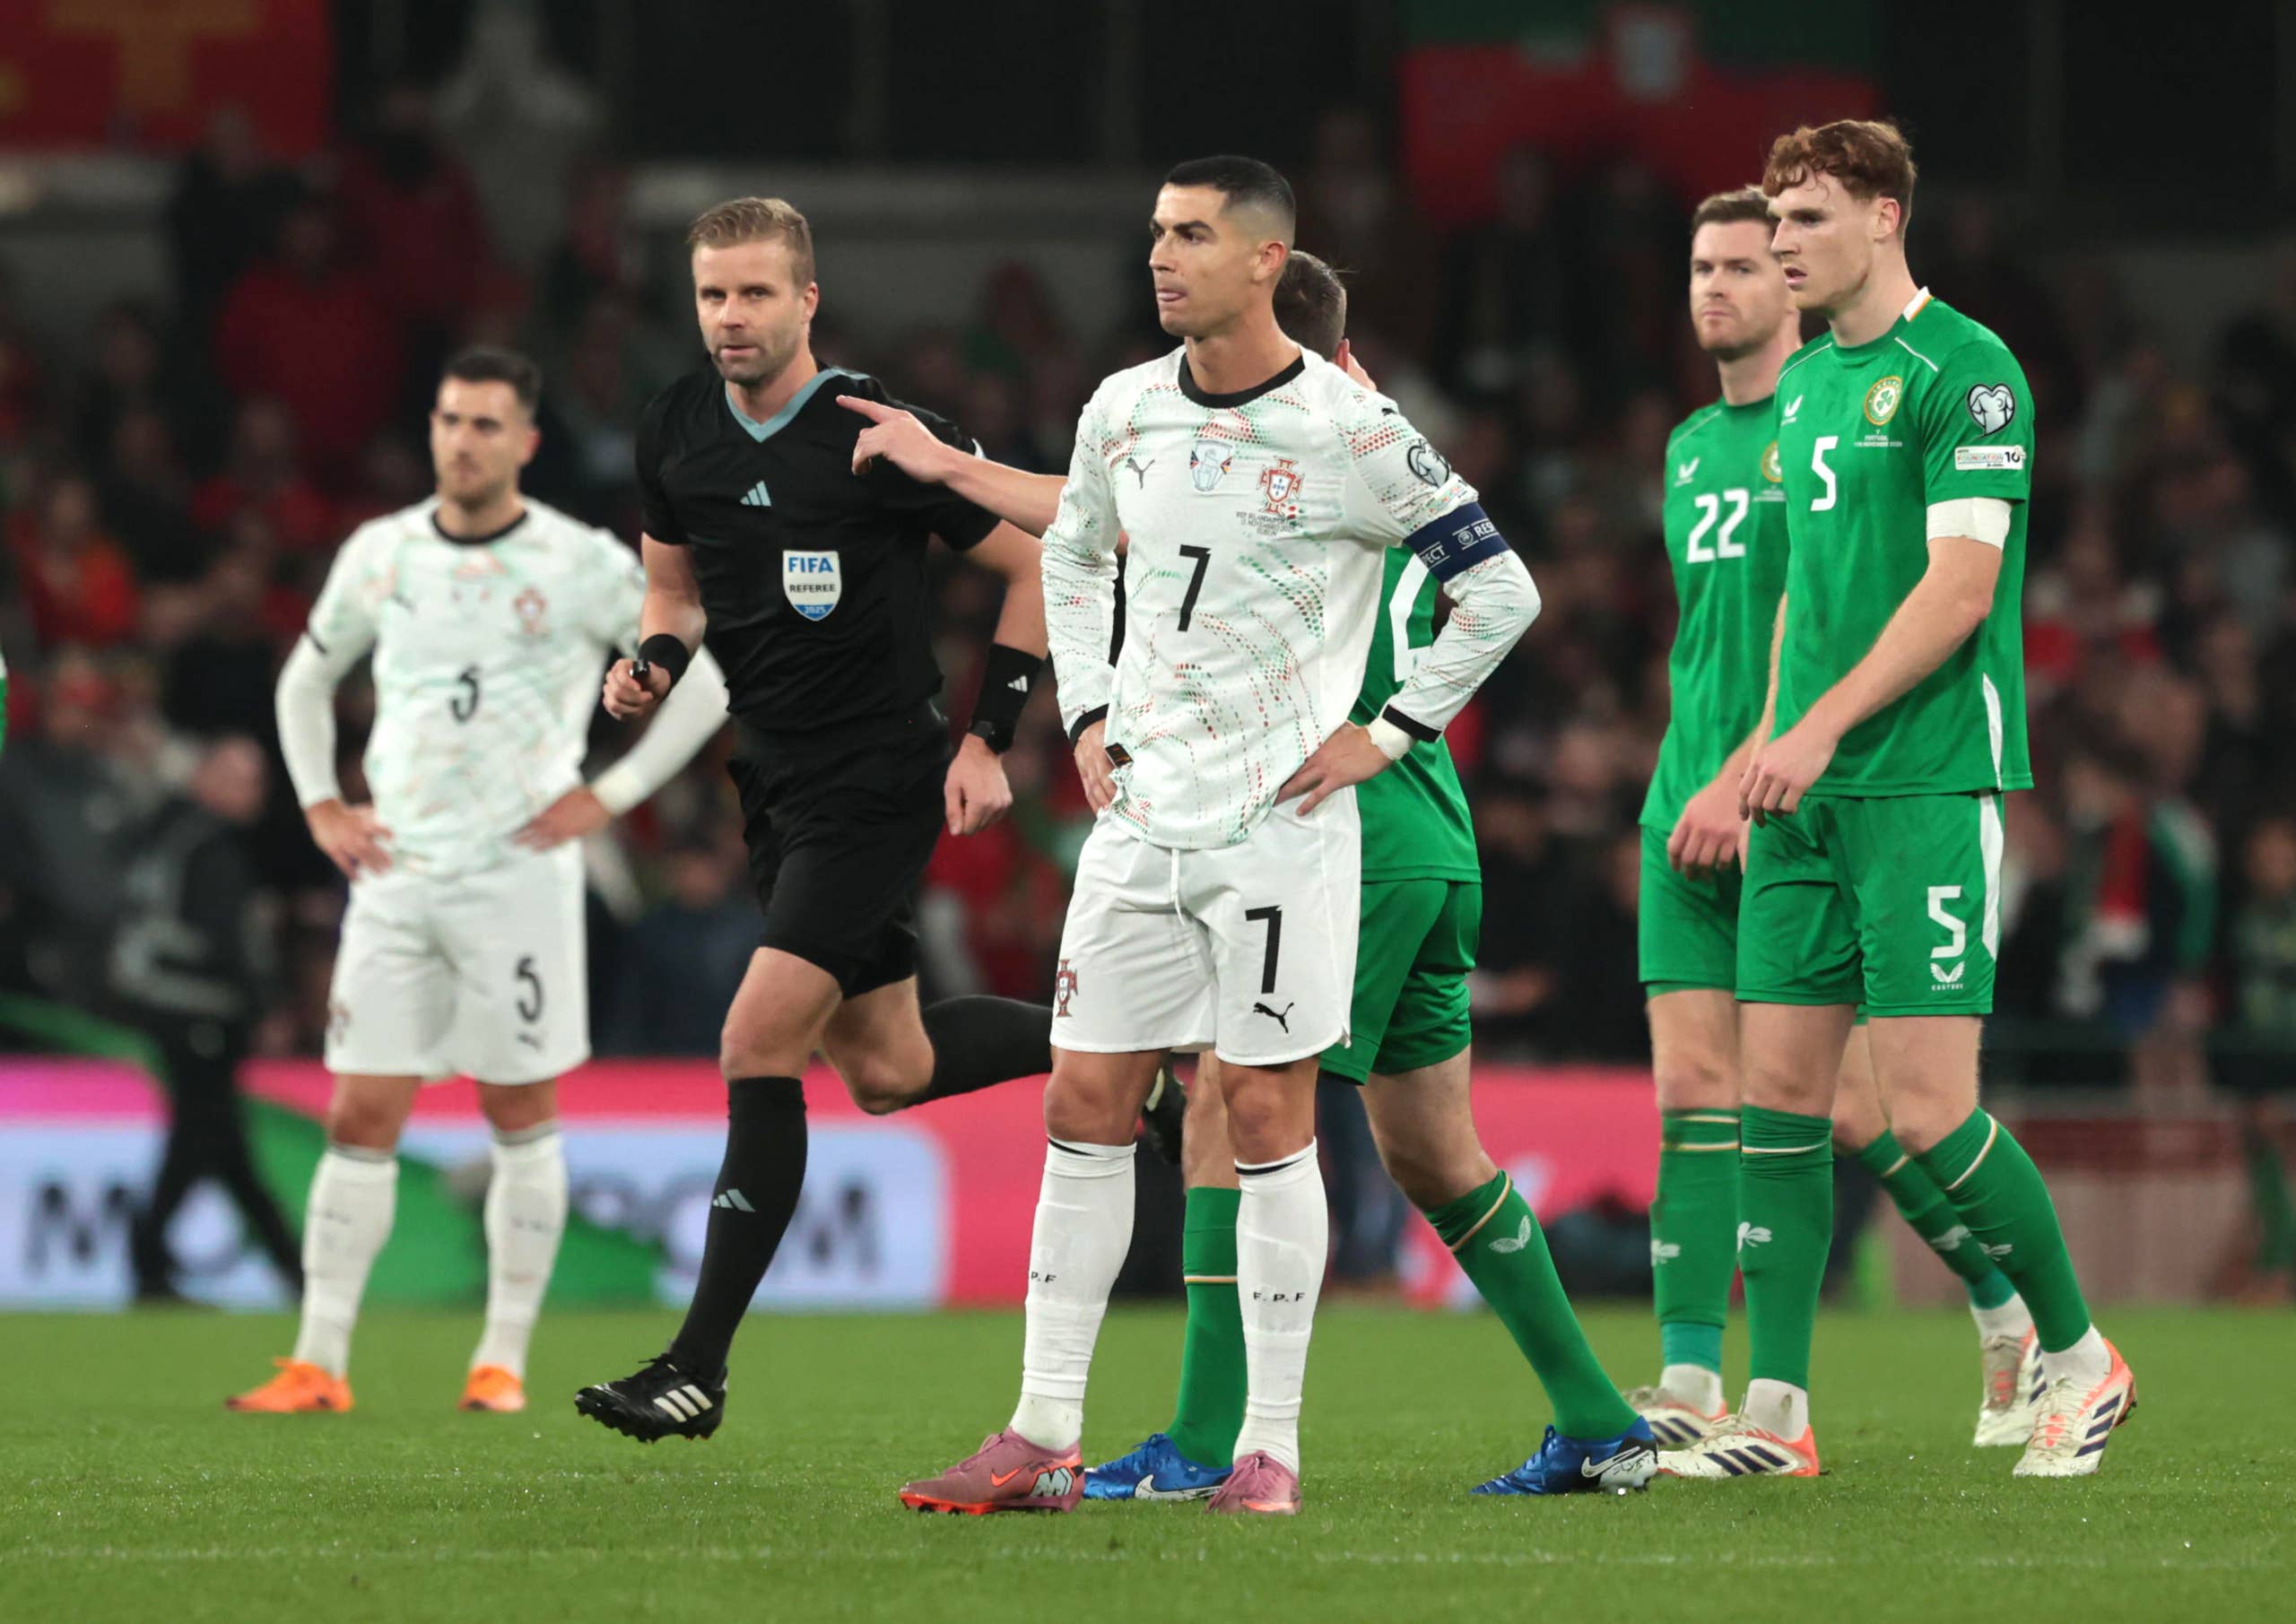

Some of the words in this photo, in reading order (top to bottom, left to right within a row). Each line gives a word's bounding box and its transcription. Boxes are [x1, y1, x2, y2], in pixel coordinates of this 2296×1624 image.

[1810, 435, 1839, 512] 5
[1686, 487, 1749, 563] 22
[788, 557, 834, 573] FIFA
[789, 583, 836, 593] REFEREE
[1177, 543, 1212, 632] 7
[449, 663, 480, 724] 5
[1245, 905, 1283, 994] 7
[1927, 885, 1966, 959] 5
[515, 952, 544, 1024] 5
